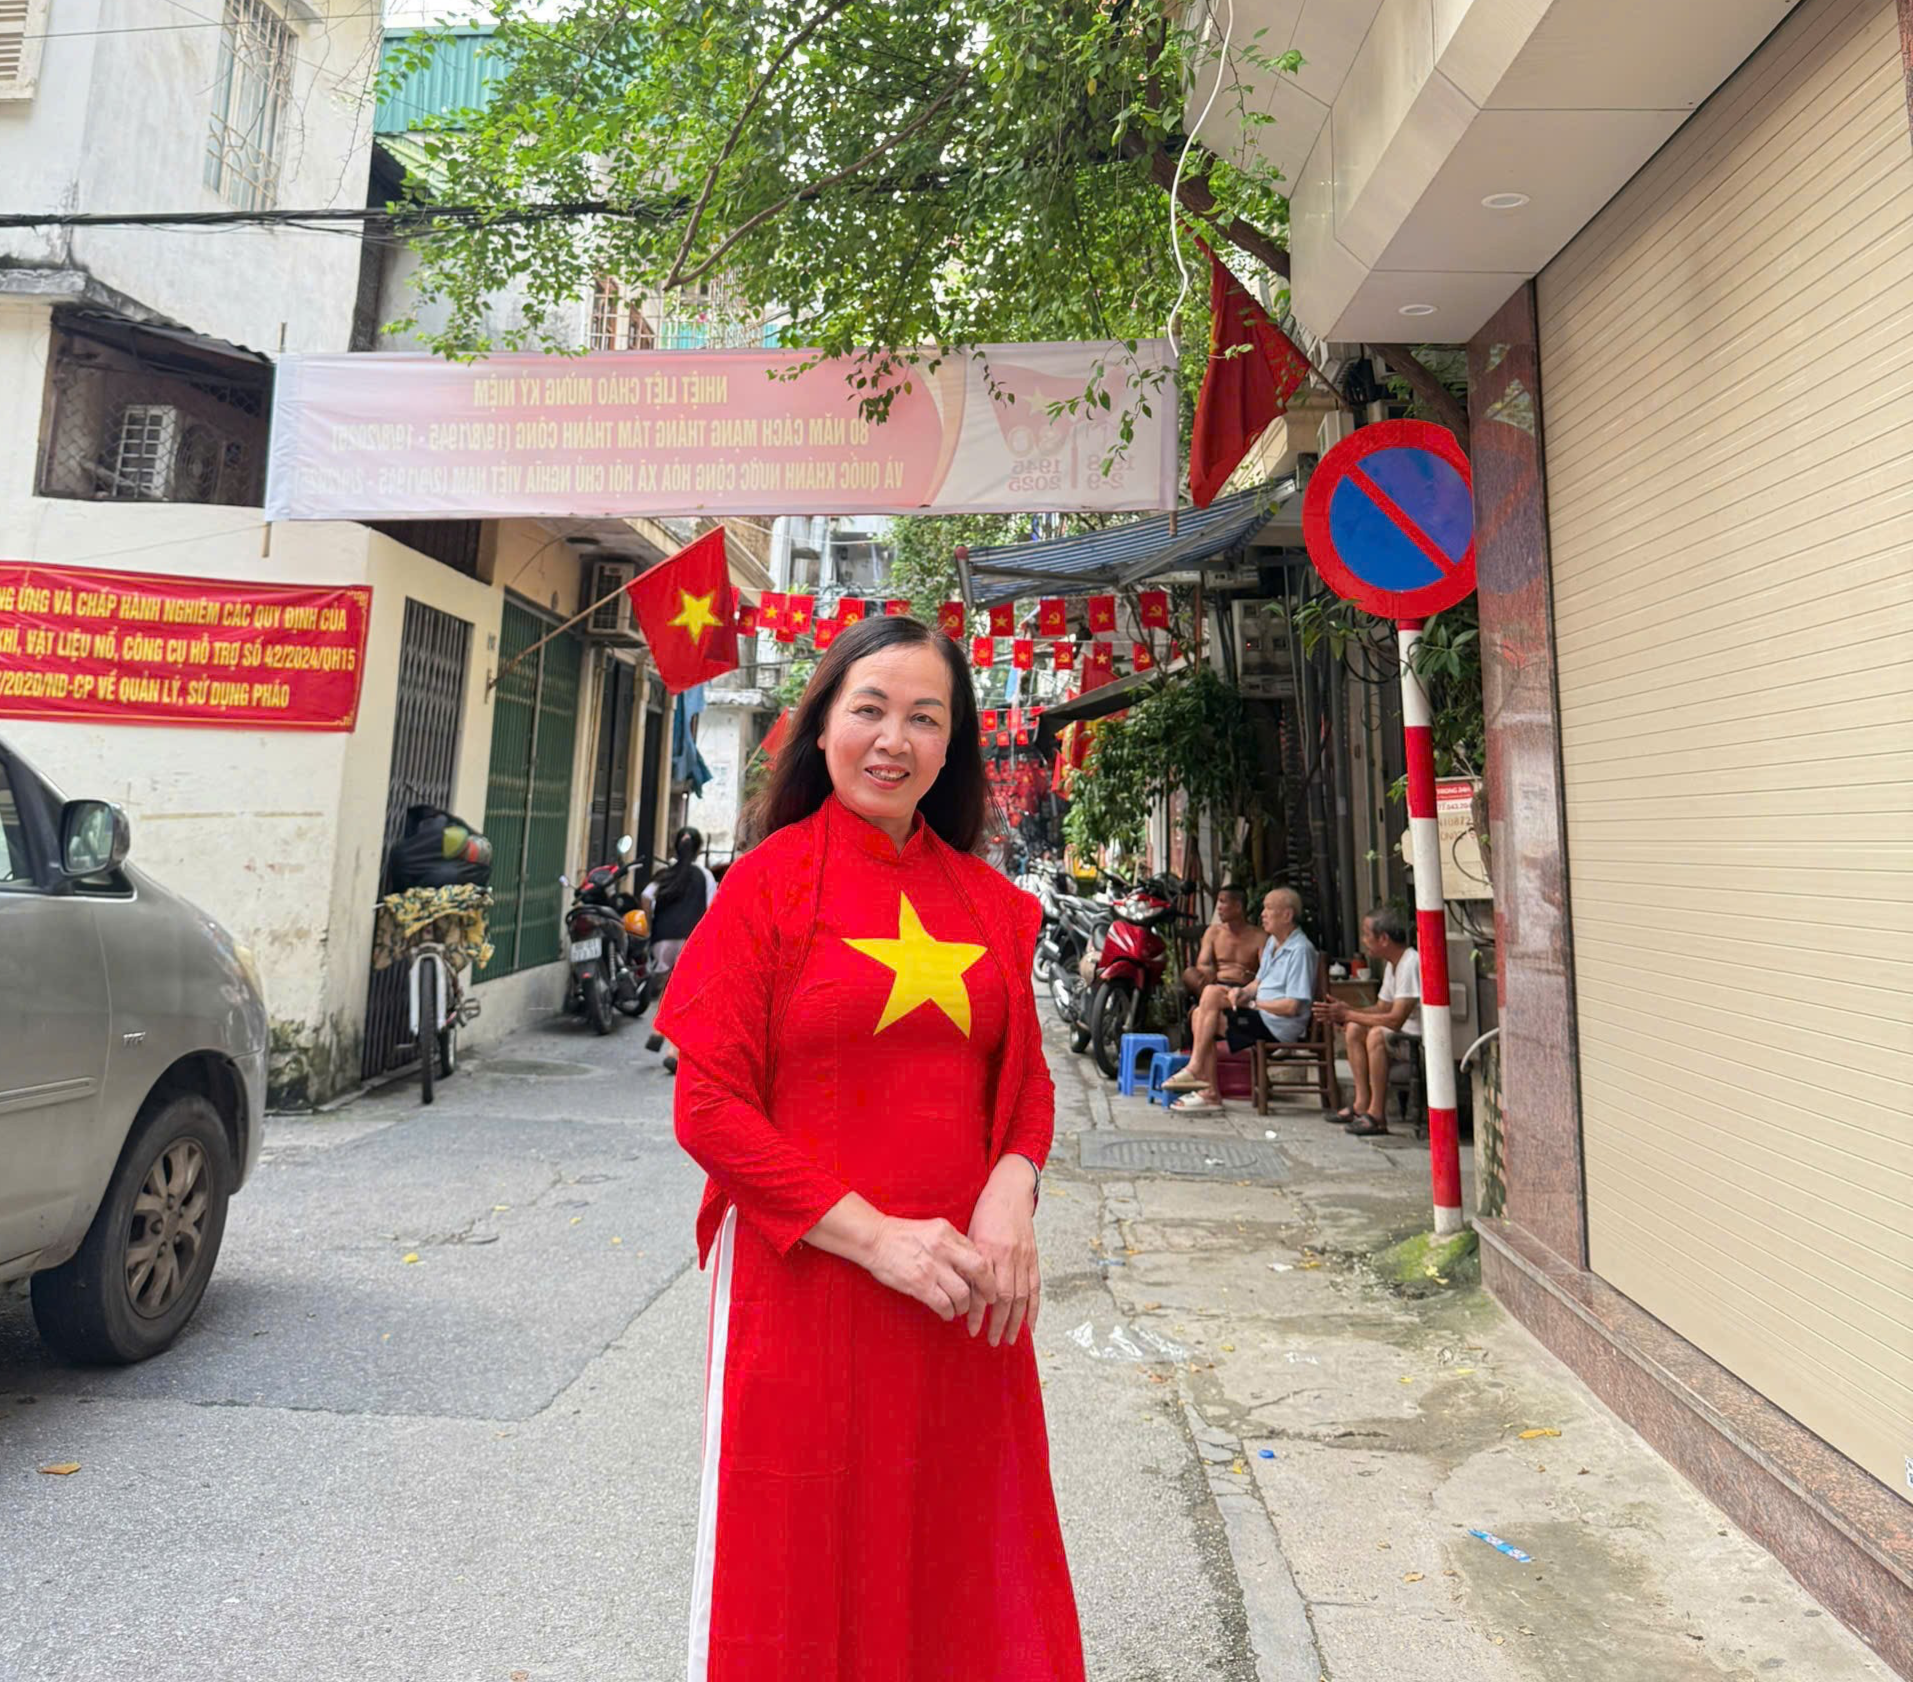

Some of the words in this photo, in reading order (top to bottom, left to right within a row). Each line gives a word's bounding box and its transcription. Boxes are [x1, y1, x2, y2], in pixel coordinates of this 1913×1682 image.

[17, 582, 50, 614] ỨNG
[53, 586, 73, 615] VÀ
[76, 586, 118, 618] CHẤP
[119, 592, 161, 621] HÀNH
[162, 597, 220, 625] NGHIÊM
[222, 599, 251, 627] CÁC
[254, 605, 282, 630] QUY
[284, 606, 318, 634] ĐỊNH
[320, 601, 347, 631] CỦA
[26, 625, 55, 660] VẬT
[57, 628, 91, 662] LIỆU
[93, 626, 120, 661] NỔ,
[122, 632, 164, 662] CÔNG
[166, 638, 188, 668] CỤ
[189, 632, 210, 665] HỖ
[212, 641, 242, 671] TRỢ
[242, 636, 265, 667] SỐ
[264, 644, 356, 671] 42/2024/QH15
[0, 670, 94, 700] /2020/NĐ-CP
[119, 671, 161, 703] QUẢN
[187, 673, 211, 705] SỬ
[210, 681, 250, 712] DỤNG
[252, 678, 290, 708] PHÁO
